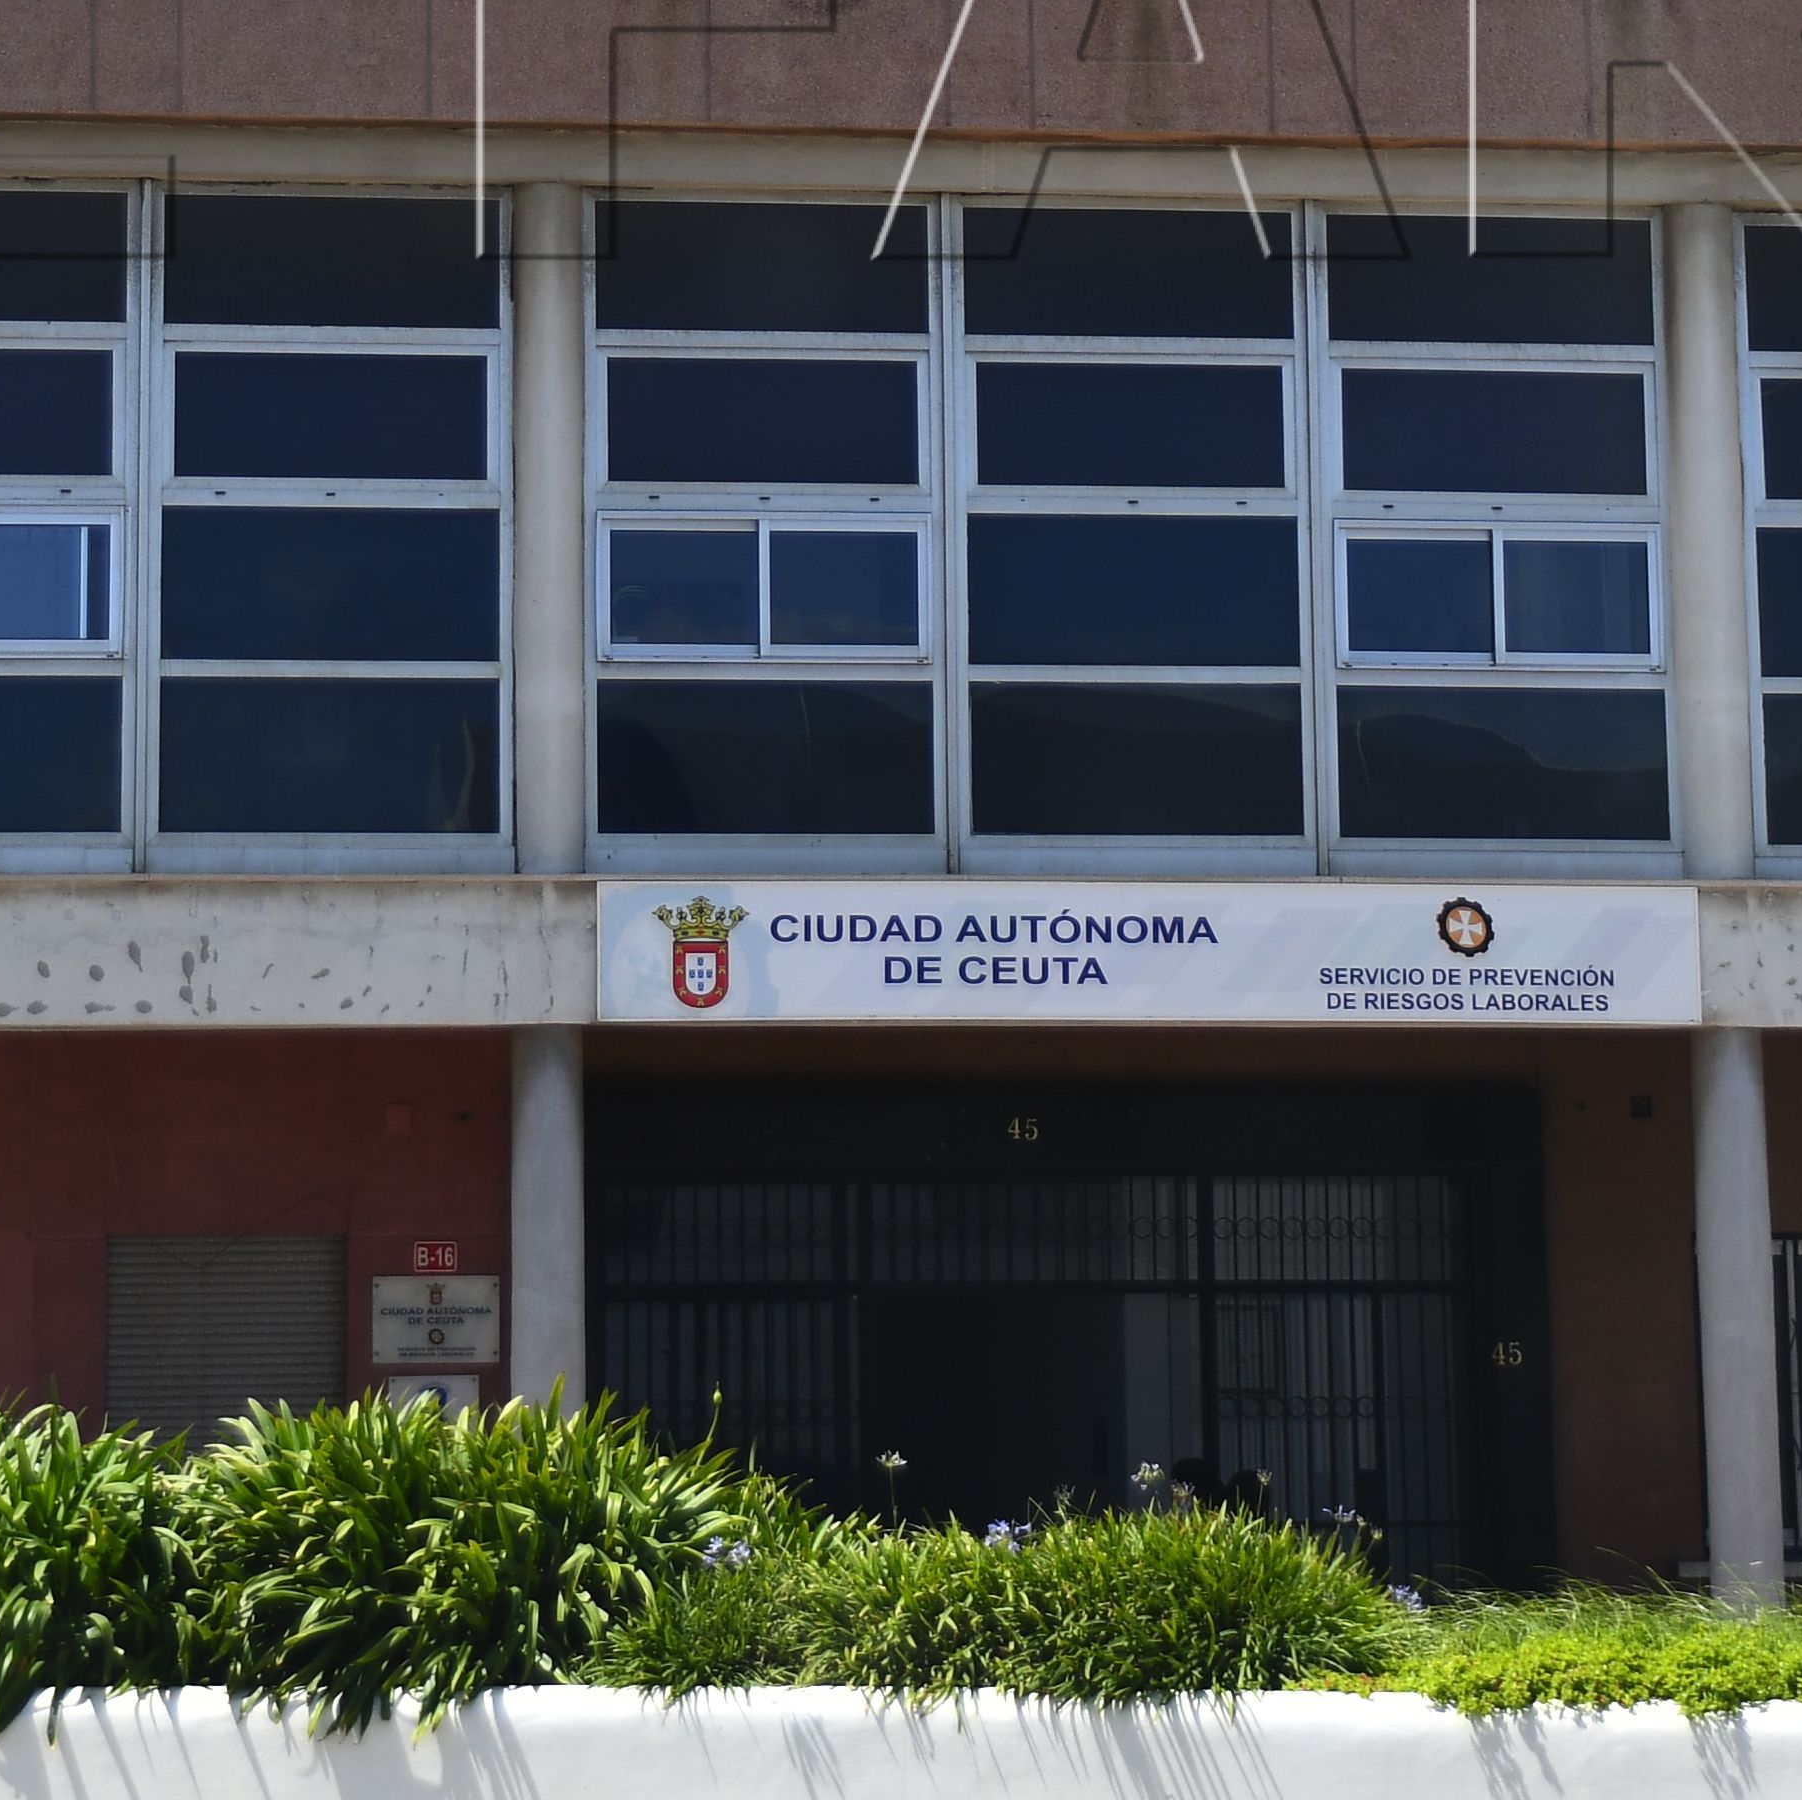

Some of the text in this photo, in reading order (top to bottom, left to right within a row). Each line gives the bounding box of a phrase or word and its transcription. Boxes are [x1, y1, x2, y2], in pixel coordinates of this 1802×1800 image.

[769, 908, 1219, 944] CIUDAD AUTÓNOMA
[883, 955, 1109, 986] DE CEUTA
[1319, 964, 1615, 987] SERVICIO DE PREVENCIÓN
[1326, 992, 1610, 1012] DE RIESGOS LABORALES
[1007, 1116, 1039, 1141] 45
[416, 1246, 455, 1267] B-16
[1491, 1341, 1523, 1365] 45
